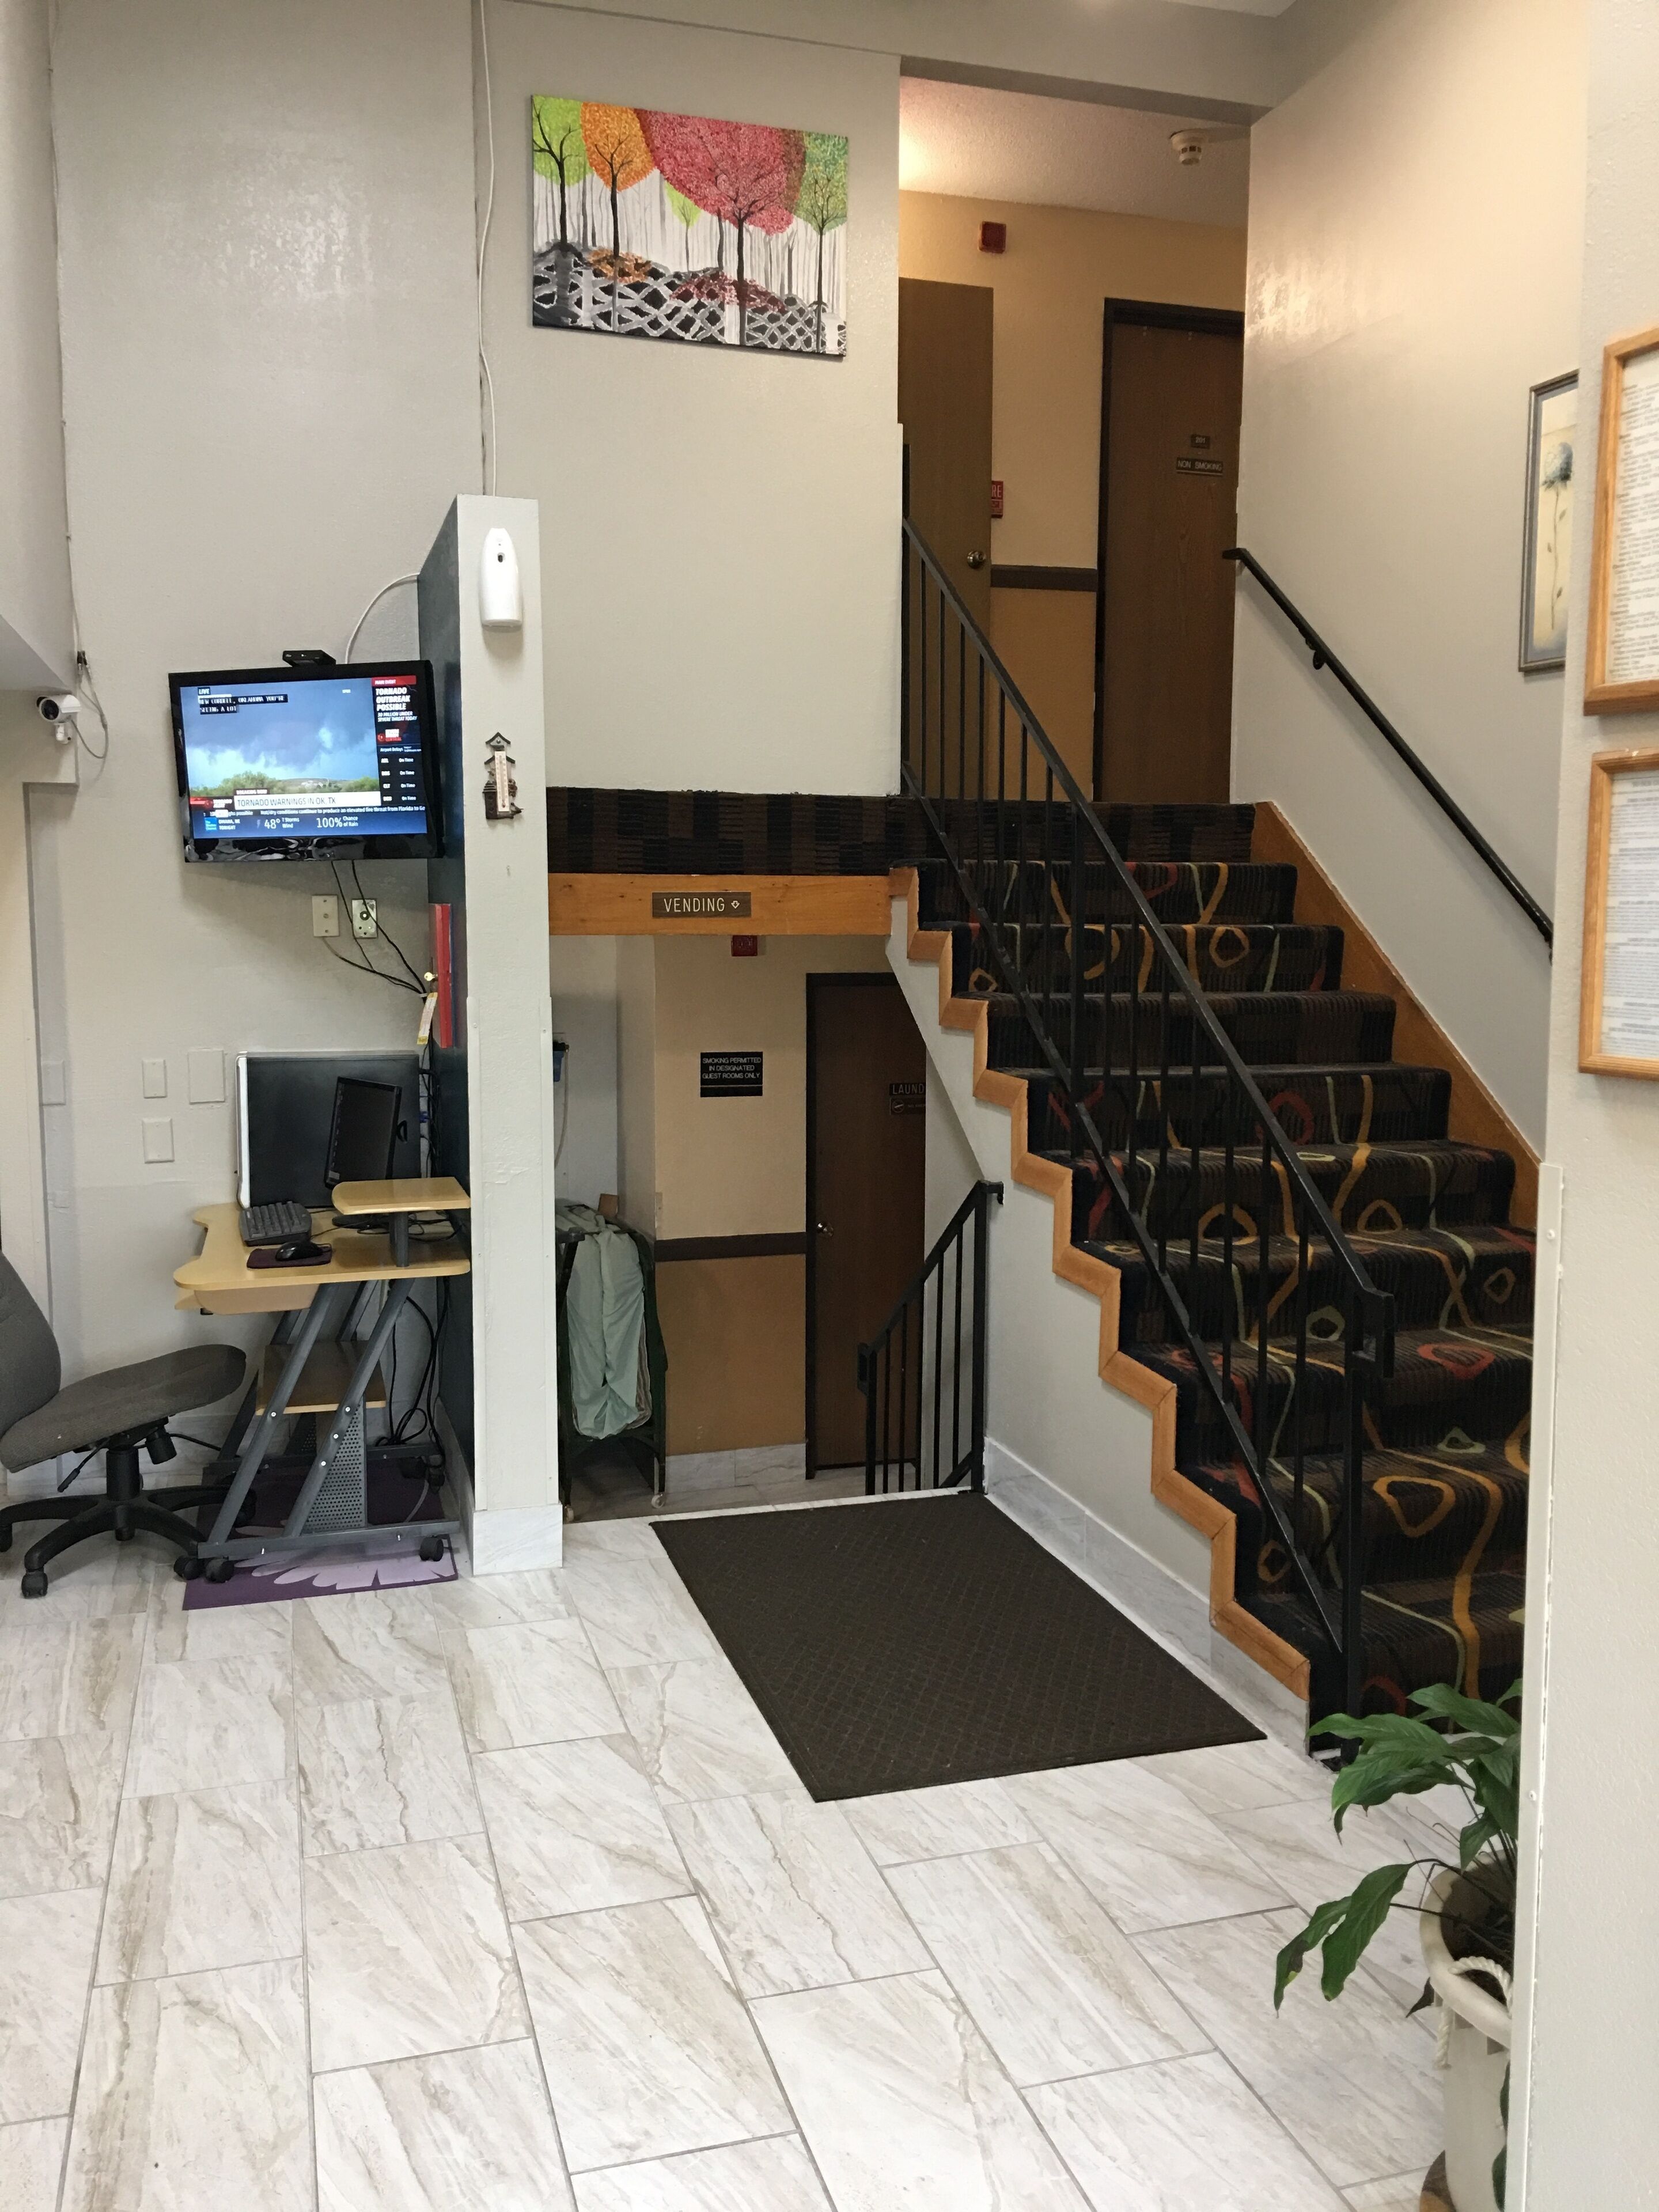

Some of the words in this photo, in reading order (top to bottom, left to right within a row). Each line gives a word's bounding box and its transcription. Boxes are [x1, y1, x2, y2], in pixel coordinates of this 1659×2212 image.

[1177, 460, 1191, 468] NON
[1195, 461, 1222, 471] SMOKING
[376, 687, 407, 695] TORNADO
[376, 695, 410, 703] OUTBREAK
[238, 799, 269, 807] TORNADO
[270, 798, 306, 806] WARNINGS
[316, 817, 343, 828] 100%
[664, 897, 725, 912] VENDING
